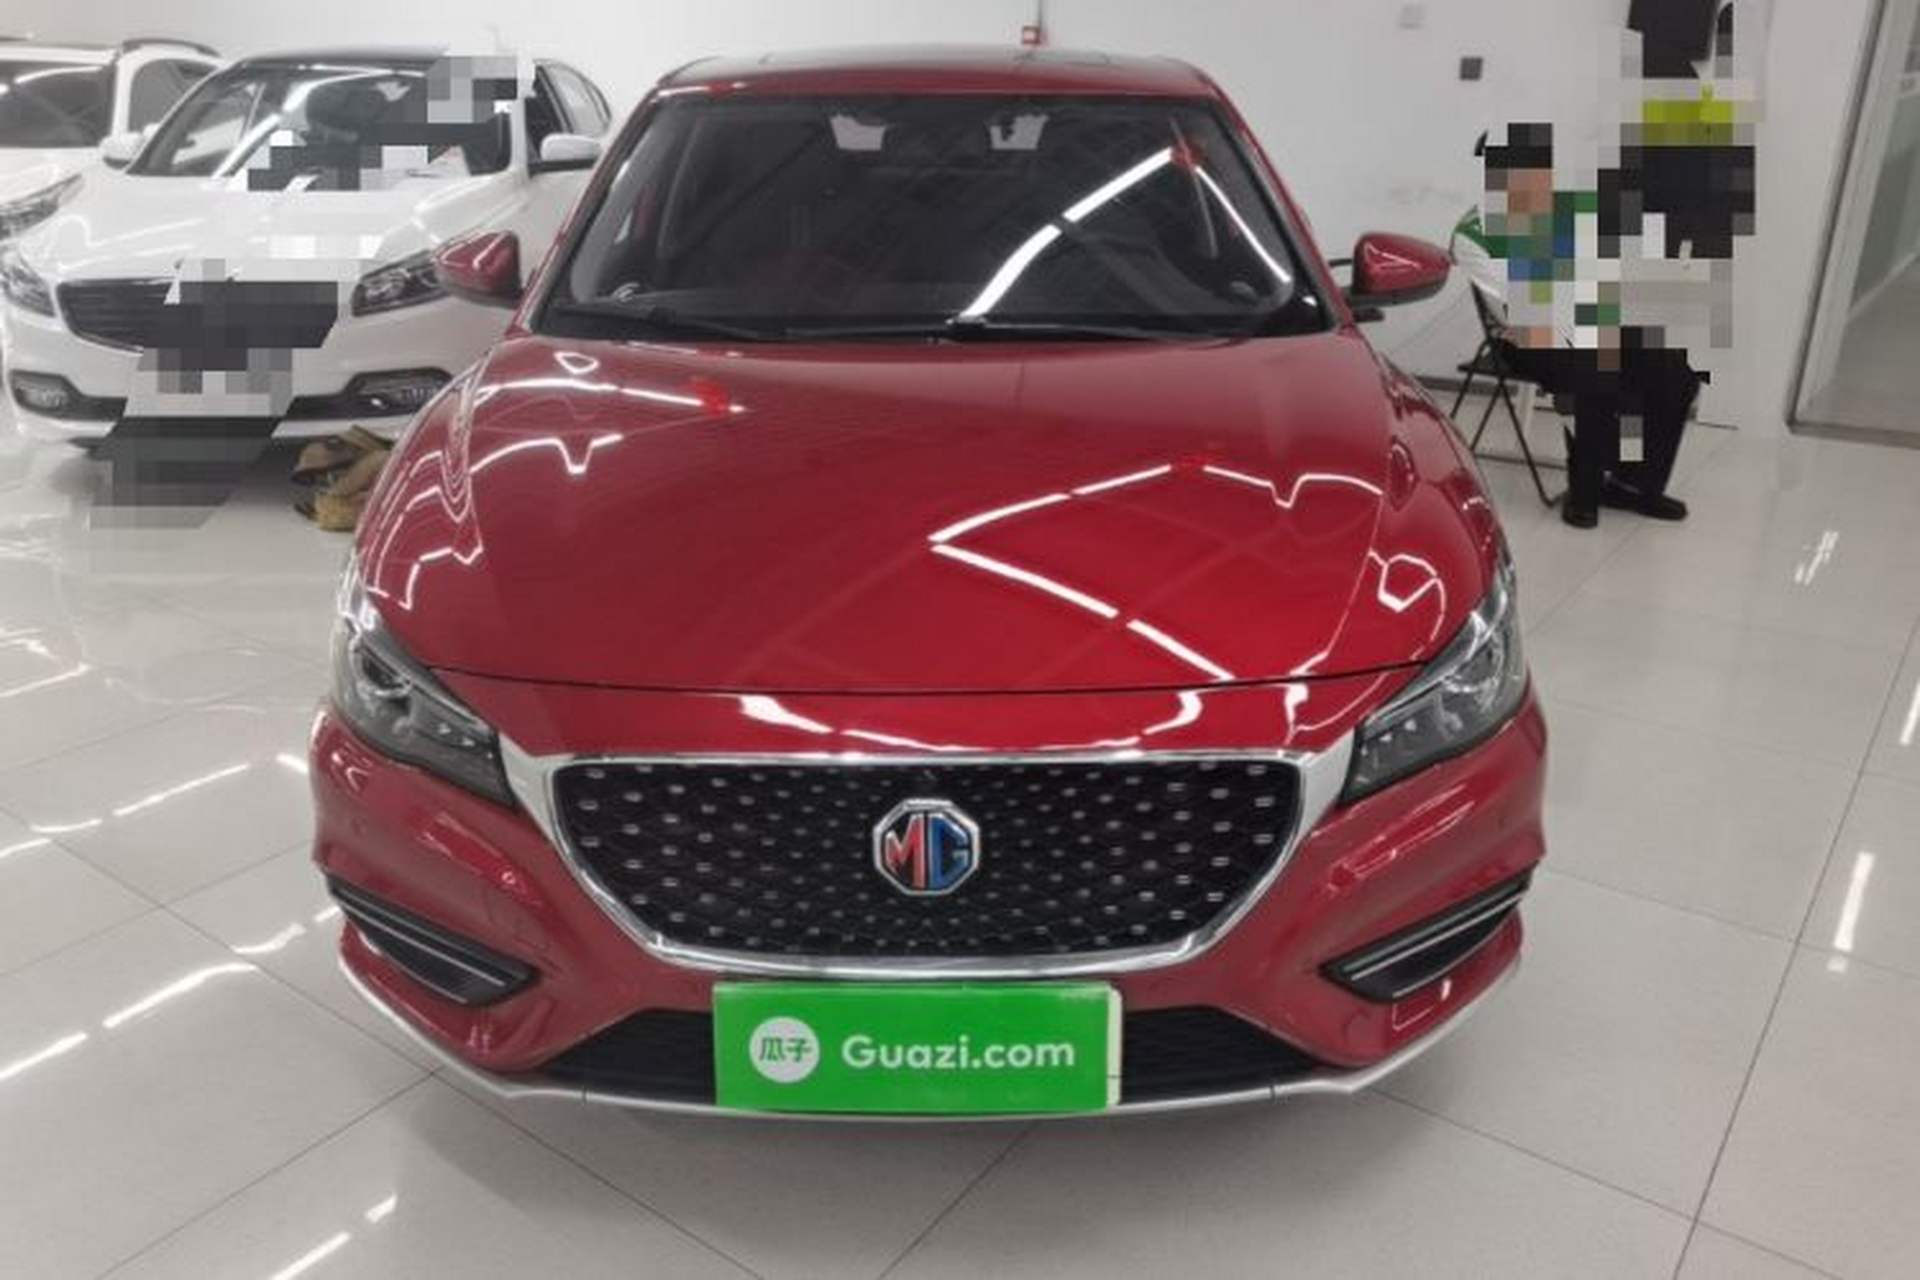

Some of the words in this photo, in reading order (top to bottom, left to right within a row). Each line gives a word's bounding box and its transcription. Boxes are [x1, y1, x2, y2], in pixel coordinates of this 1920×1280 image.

[885, 813, 969, 889] MG
[759, 1037, 812, 1063] 瓜子
[841, 1034, 1075, 1069] Guazi.com
